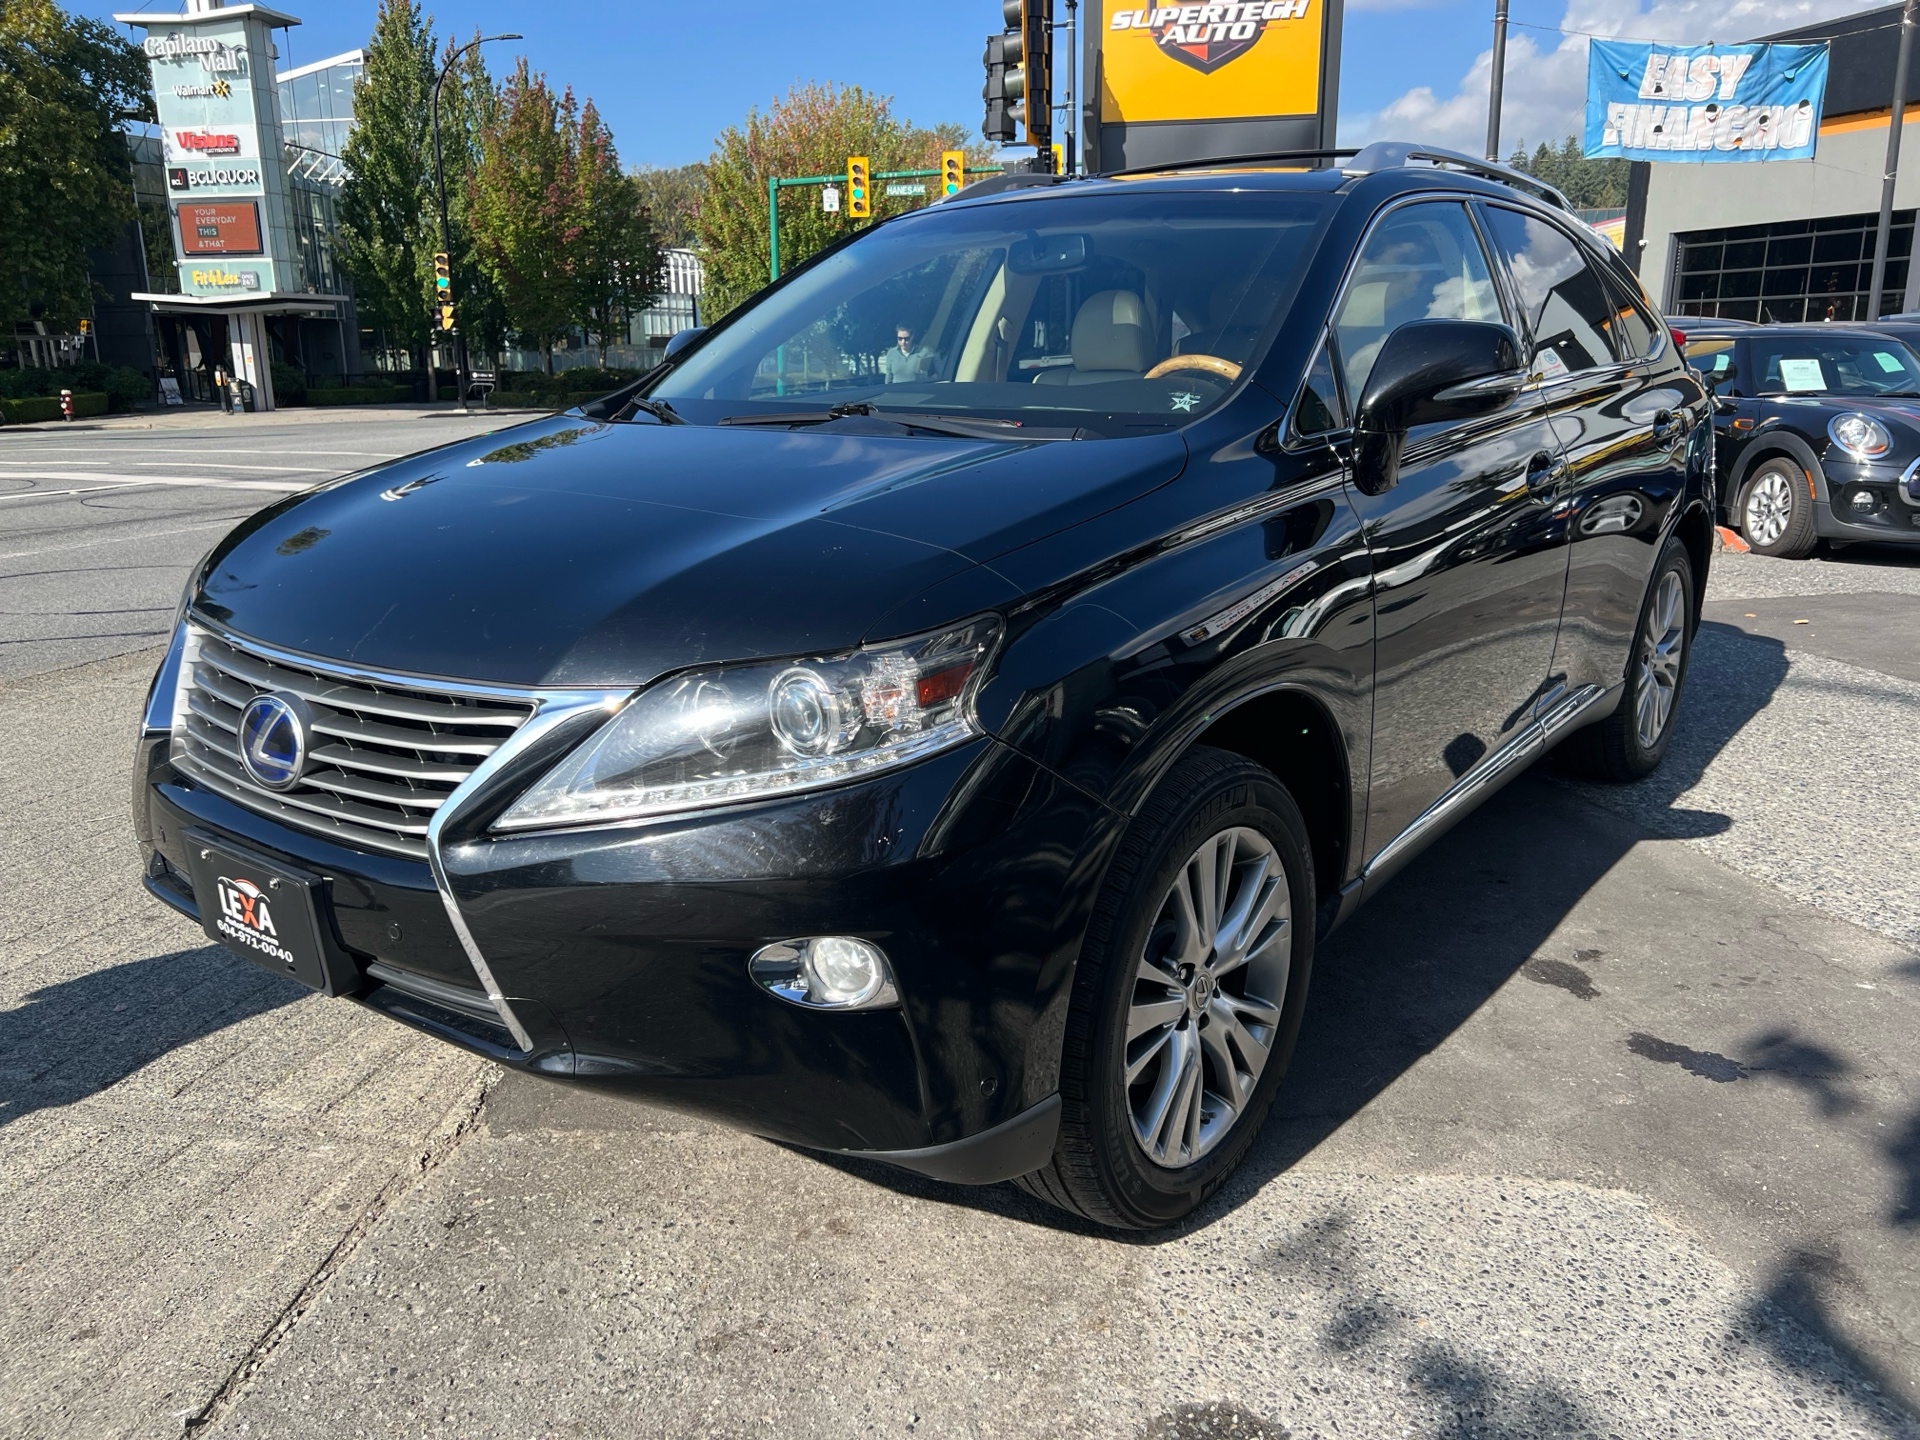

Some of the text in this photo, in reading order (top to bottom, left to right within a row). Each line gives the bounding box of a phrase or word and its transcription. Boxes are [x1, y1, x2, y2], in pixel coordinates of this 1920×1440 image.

[1110, 0, 1310, 30] SUPERTECH
[1159, 22, 1257, 45] AUTO
[144, 33, 218, 60] Capilano
[198, 50, 239, 72] Mall
[1638, 54, 1752, 102] EASY
[172, 85, 214, 96] Walmart
[1602, 101, 1814, 151] FINANCING
[176, 131, 235, 149] Visions
[887, 185, 912, 195] HANES
[194, 208, 216, 216] YOUR
[195, 216, 236, 225] EVERYDAY
[198, 228, 217, 236] THIS
[217, 883, 277, 936] LEXA
[217, 919, 293, 963] 604-971-0040
